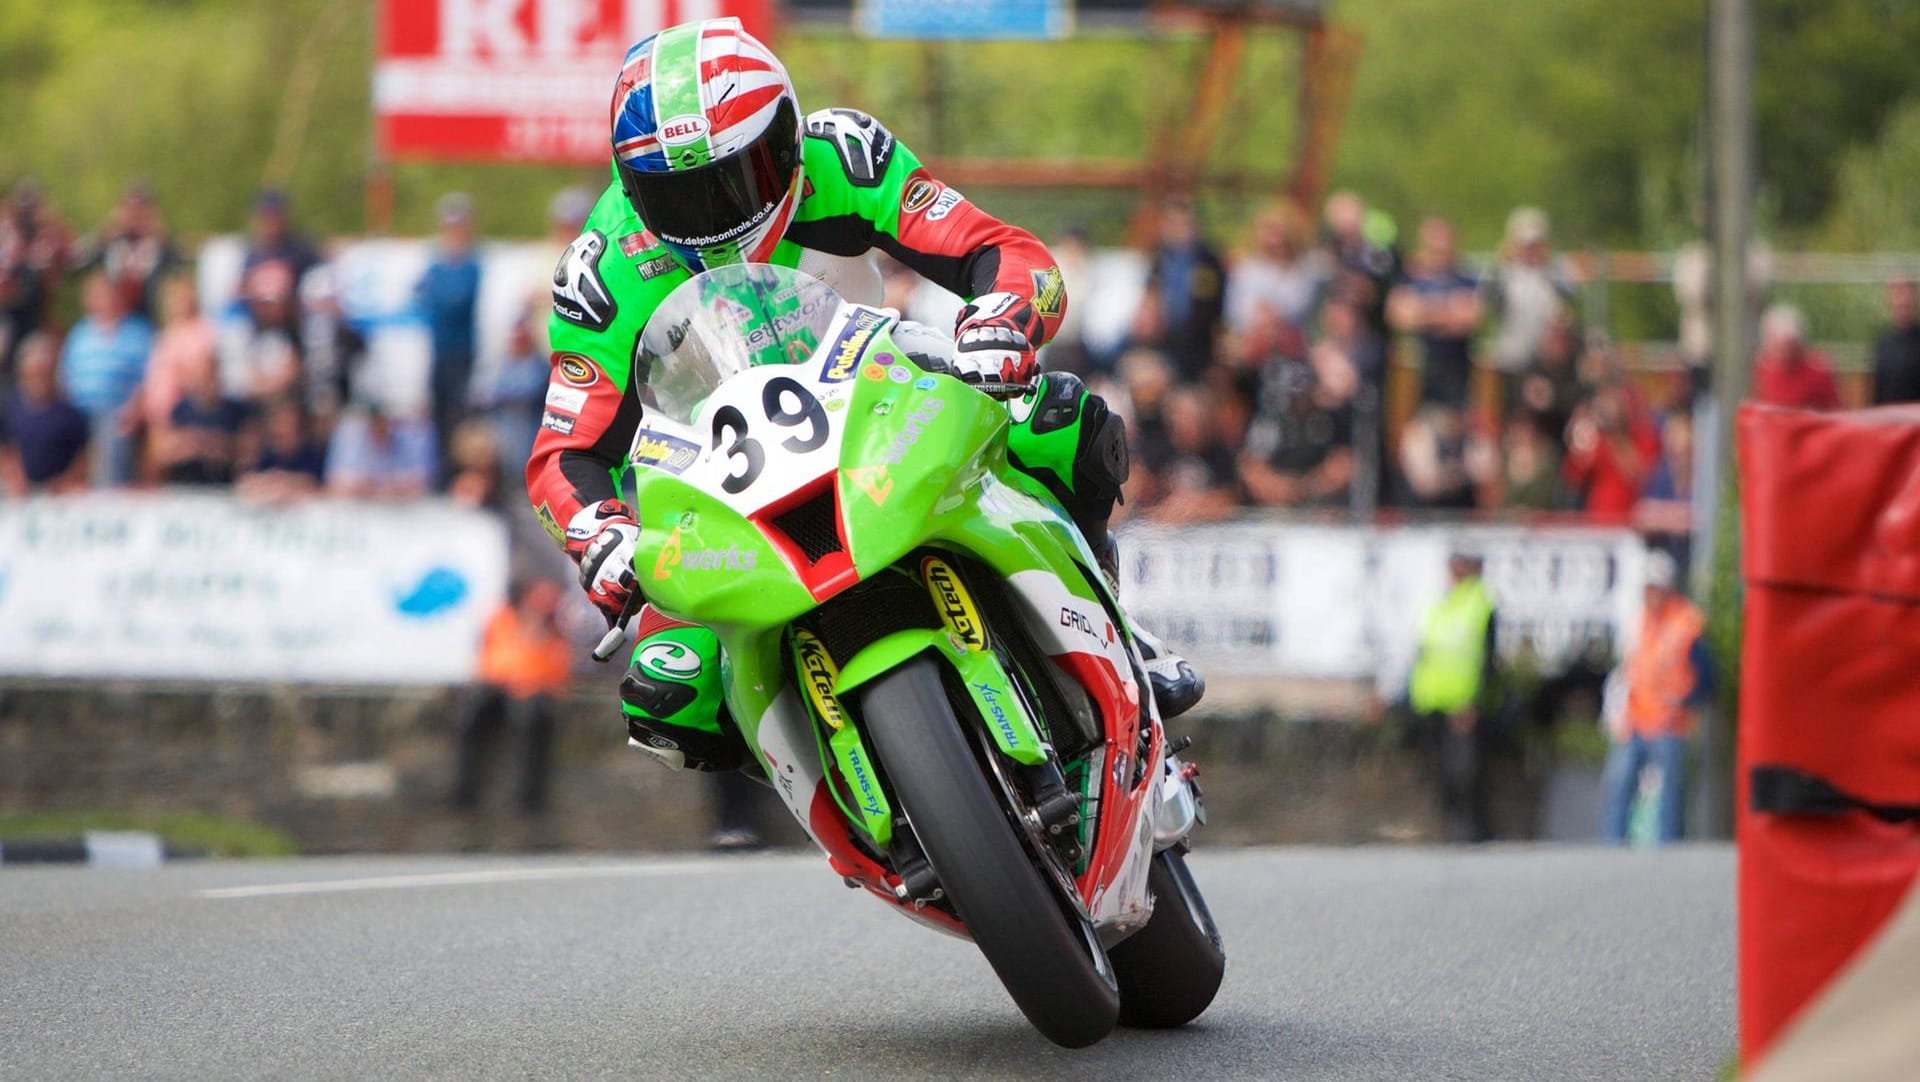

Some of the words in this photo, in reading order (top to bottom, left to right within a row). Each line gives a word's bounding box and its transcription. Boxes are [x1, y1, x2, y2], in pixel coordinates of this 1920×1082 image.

[664, 121, 702, 140] BELL
[661, 201, 775, 246] www.delphcontrols.co.uk
[711, 374, 830, 495] 39
[974, 681, 1020, 748] TRANS-FIX
[848, 747, 885, 818] TRANS-FIX
